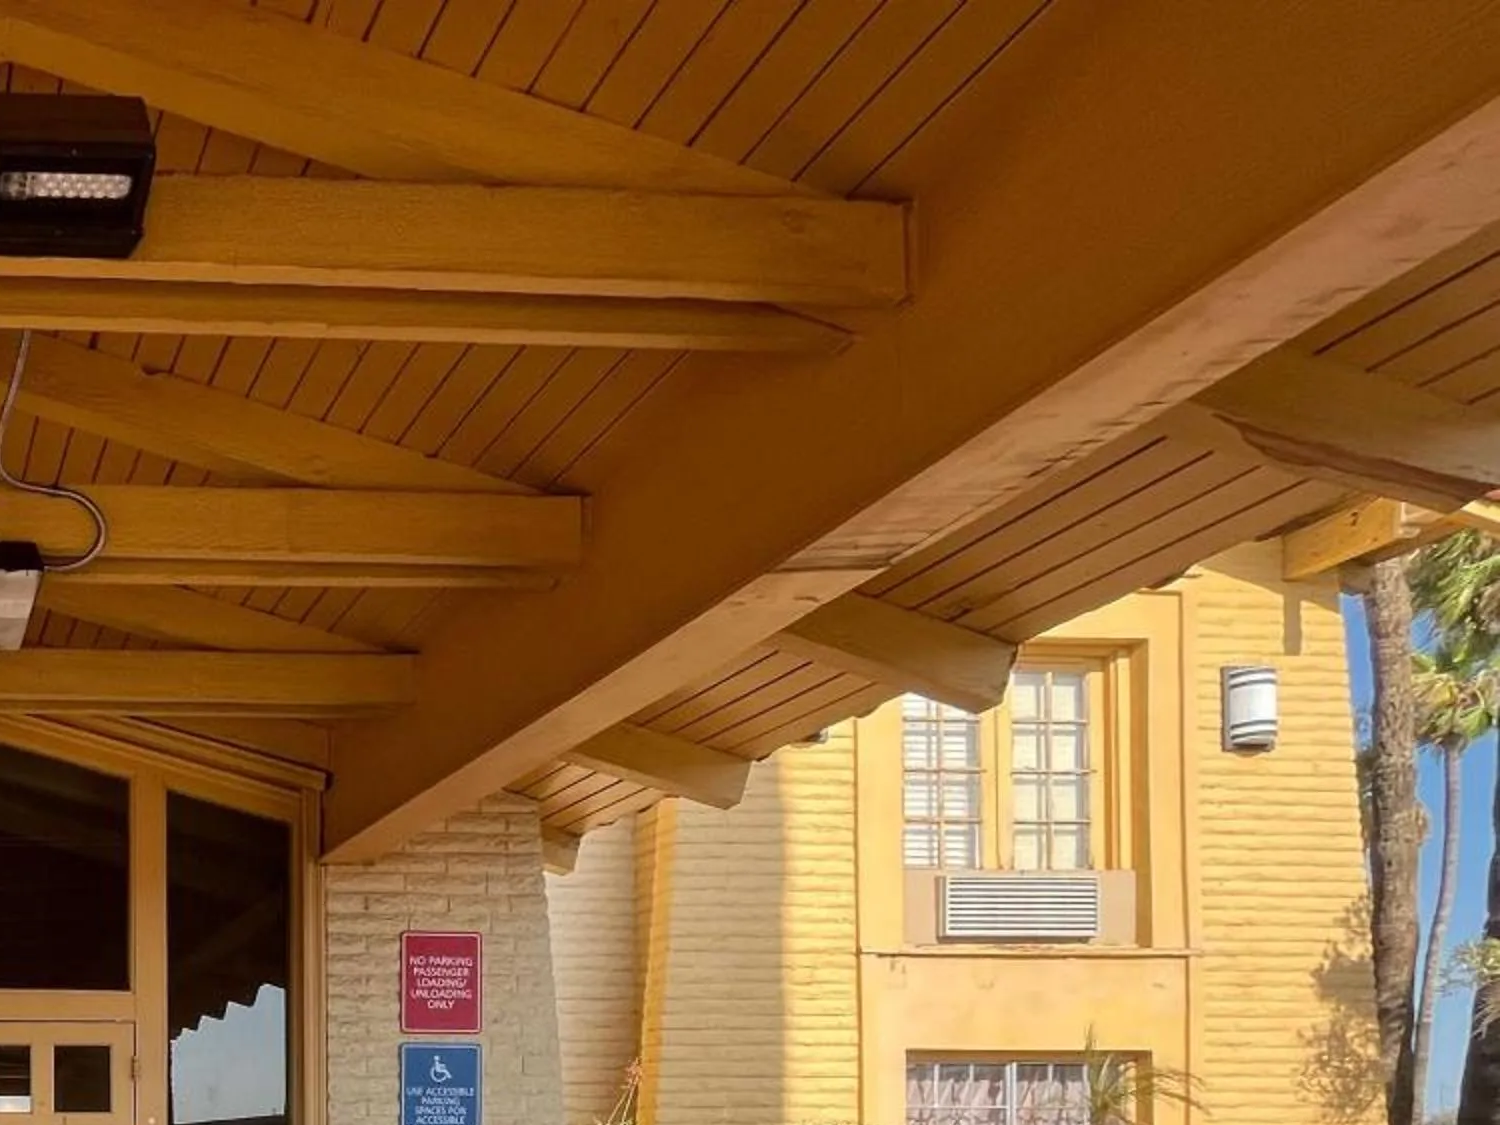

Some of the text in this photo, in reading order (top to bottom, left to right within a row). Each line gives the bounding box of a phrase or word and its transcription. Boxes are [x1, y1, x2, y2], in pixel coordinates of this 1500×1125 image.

[409, 955, 426, 967] NO
[409, 989, 472, 999] UNLOADING
[427, 1000, 455, 1009] ONLY
[426, 1087, 475, 1097] ACCESSIBLE
[415, 1115, 466, 1125] ACCESSIBLE
